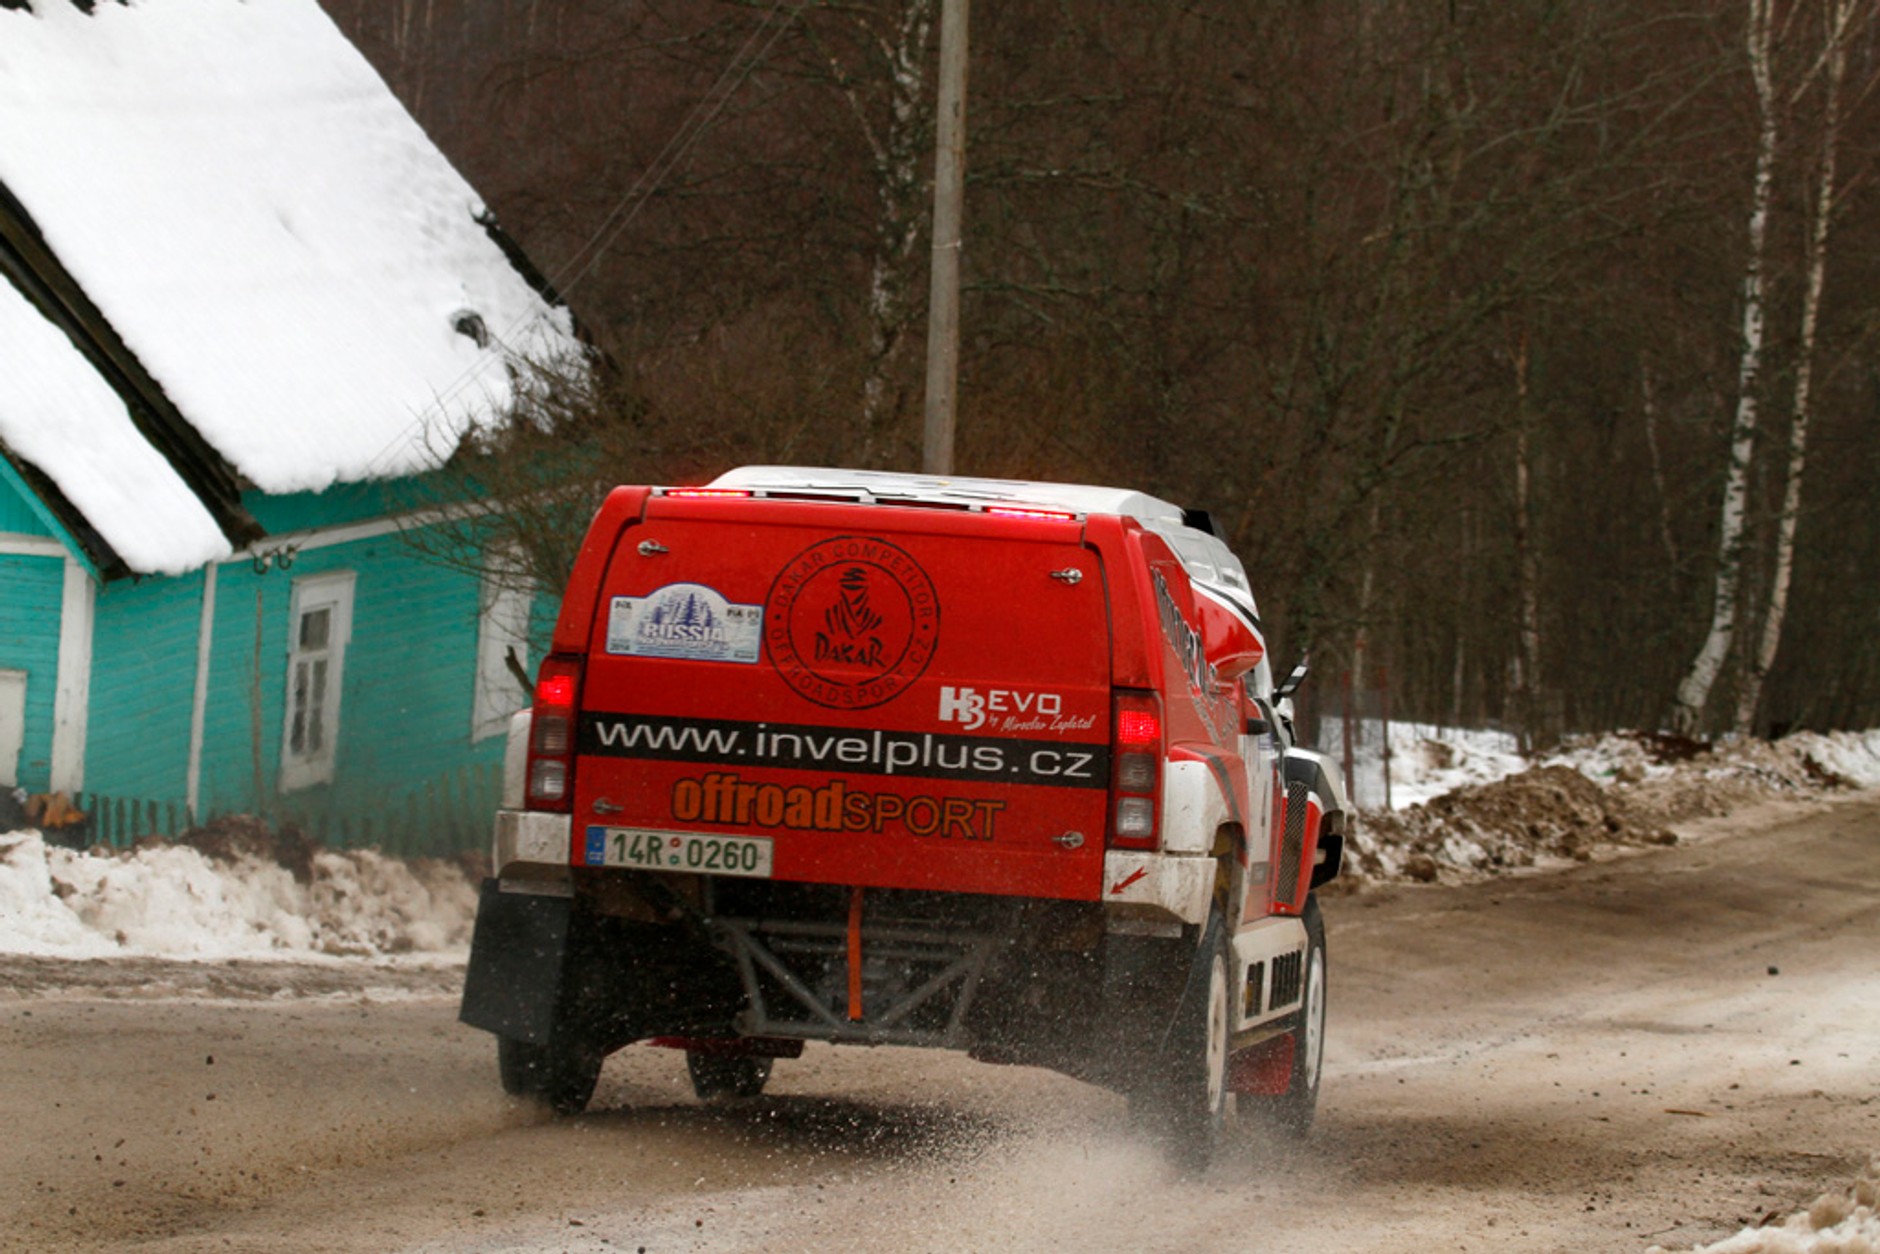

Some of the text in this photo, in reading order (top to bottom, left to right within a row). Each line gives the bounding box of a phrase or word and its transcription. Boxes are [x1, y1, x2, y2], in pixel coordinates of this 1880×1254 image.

[775, 543, 933, 618] DAKAR COMPETITOR
[643, 621, 727, 642] RUSSIA
[814, 631, 887, 668] DAKAR
[595, 721, 1094, 778] www.invelplus.cz
[613, 833, 758, 871] 14R 0260
